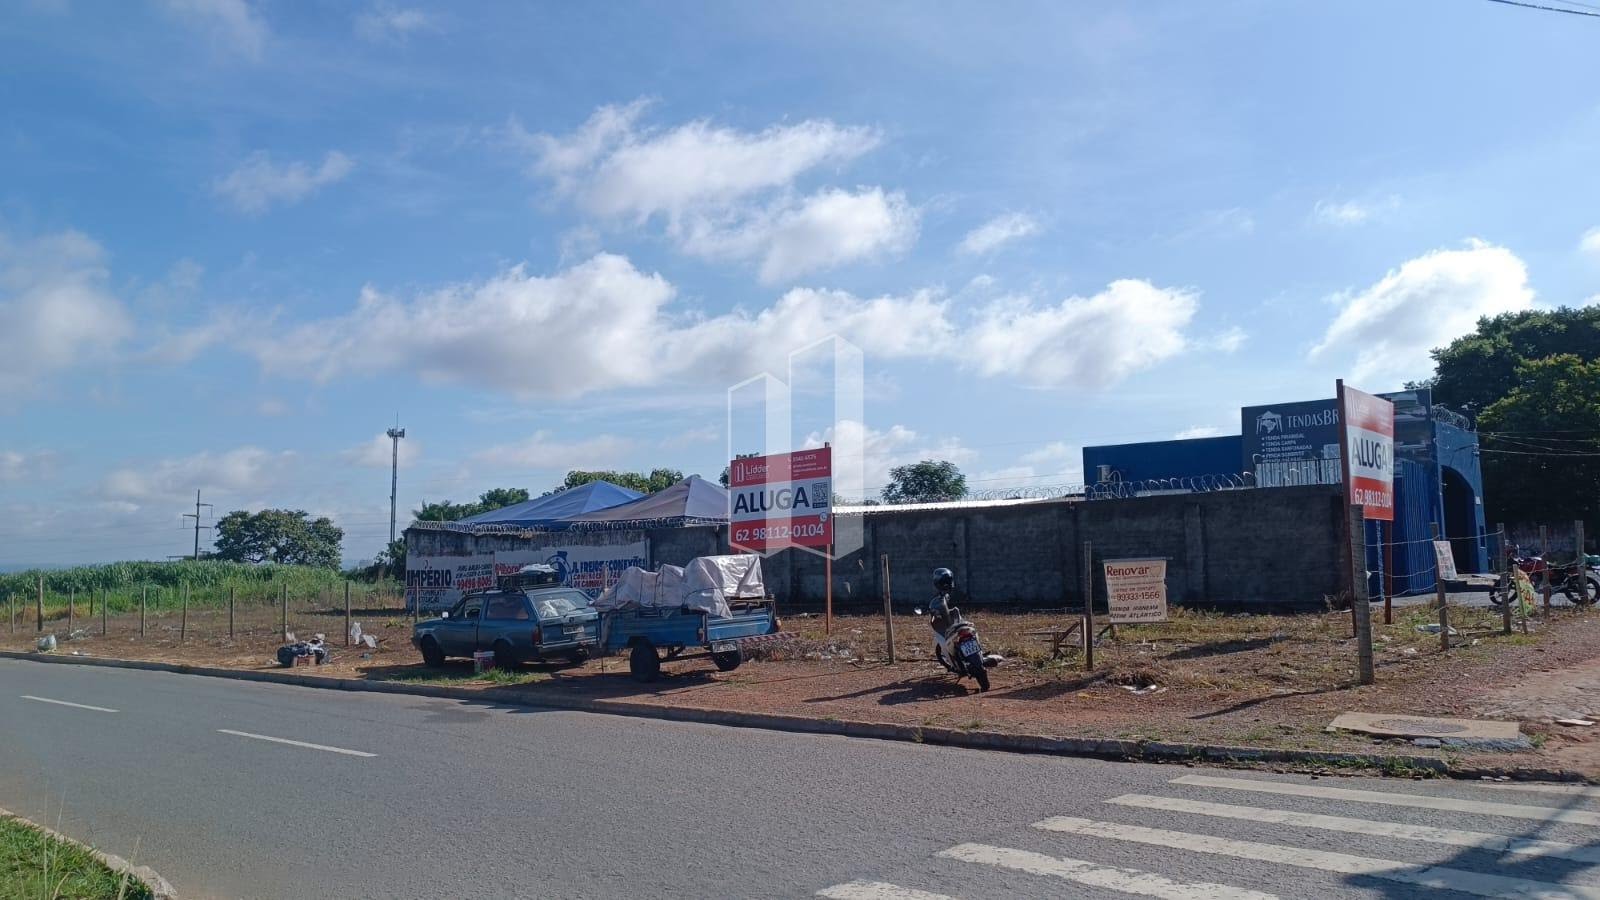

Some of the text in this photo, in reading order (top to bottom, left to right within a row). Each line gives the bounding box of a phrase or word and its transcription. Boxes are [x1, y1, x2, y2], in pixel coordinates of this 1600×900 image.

[1352, 437, 1388, 472] ALUGA
[733, 486, 810, 514] ALUGA
[1354, 487, 1364, 505] 62
[735, 523, 825, 541] 62 98112-0104
[406, 566, 452, 587] IMPÉRIO
[1106, 565, 1150, 576] Renovar
